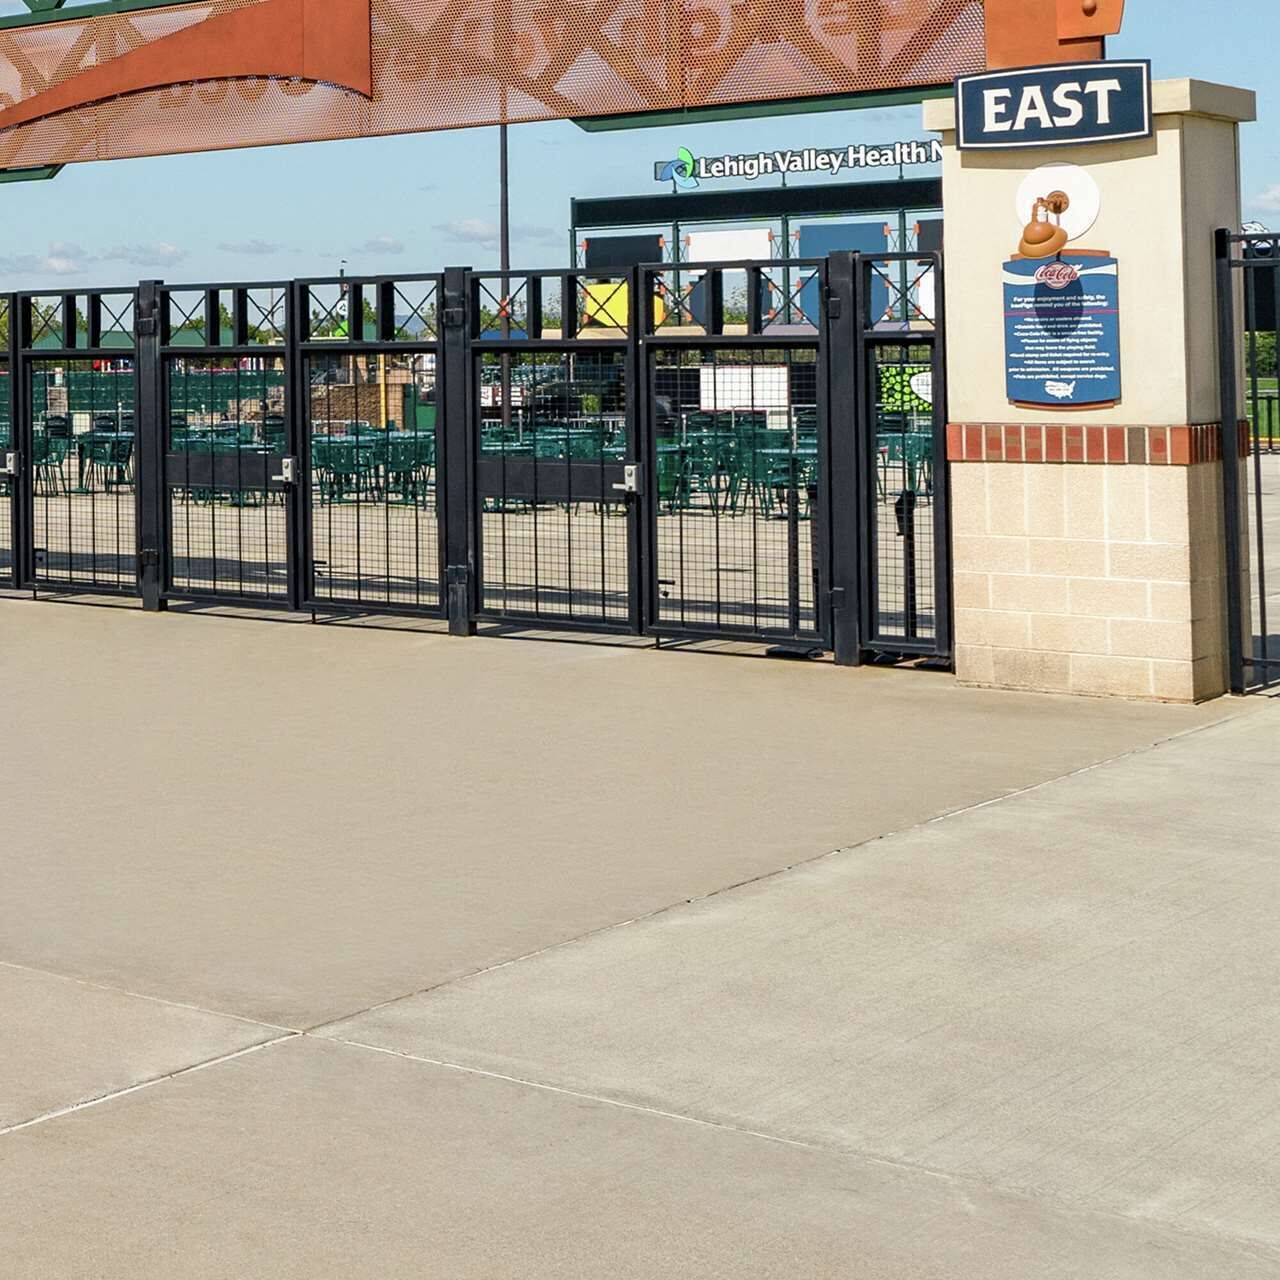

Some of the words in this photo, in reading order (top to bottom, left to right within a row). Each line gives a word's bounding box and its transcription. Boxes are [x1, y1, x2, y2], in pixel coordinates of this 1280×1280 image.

[982, 78, 1122, 133] EAST
[699, 155, 774, 180] Lehigh
[773, 148, 842, 175] Valley
[847, 140, 927, 168] Health
